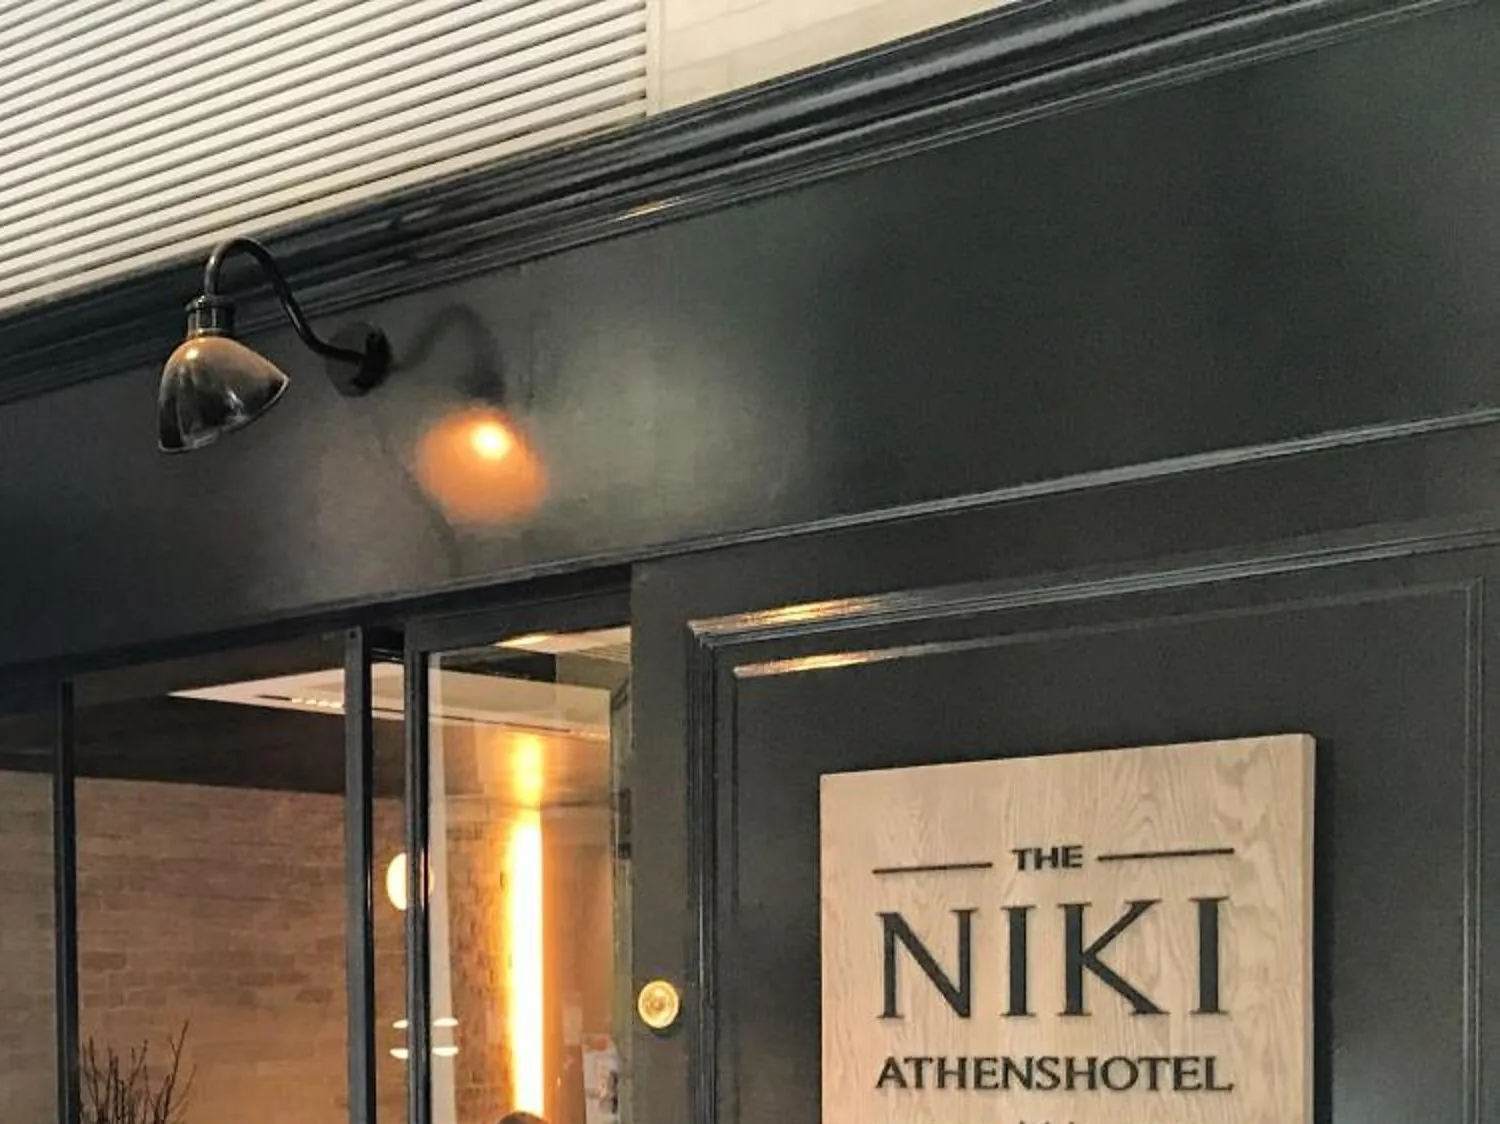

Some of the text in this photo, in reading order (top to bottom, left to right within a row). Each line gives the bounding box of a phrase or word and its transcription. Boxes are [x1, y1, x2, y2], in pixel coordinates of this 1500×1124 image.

[1012, 844, 1084, 871] THE
[875, 896, 1231, 1019] NIKI
[875, 1056, 1235, 1091] ATHENSHOTEL
